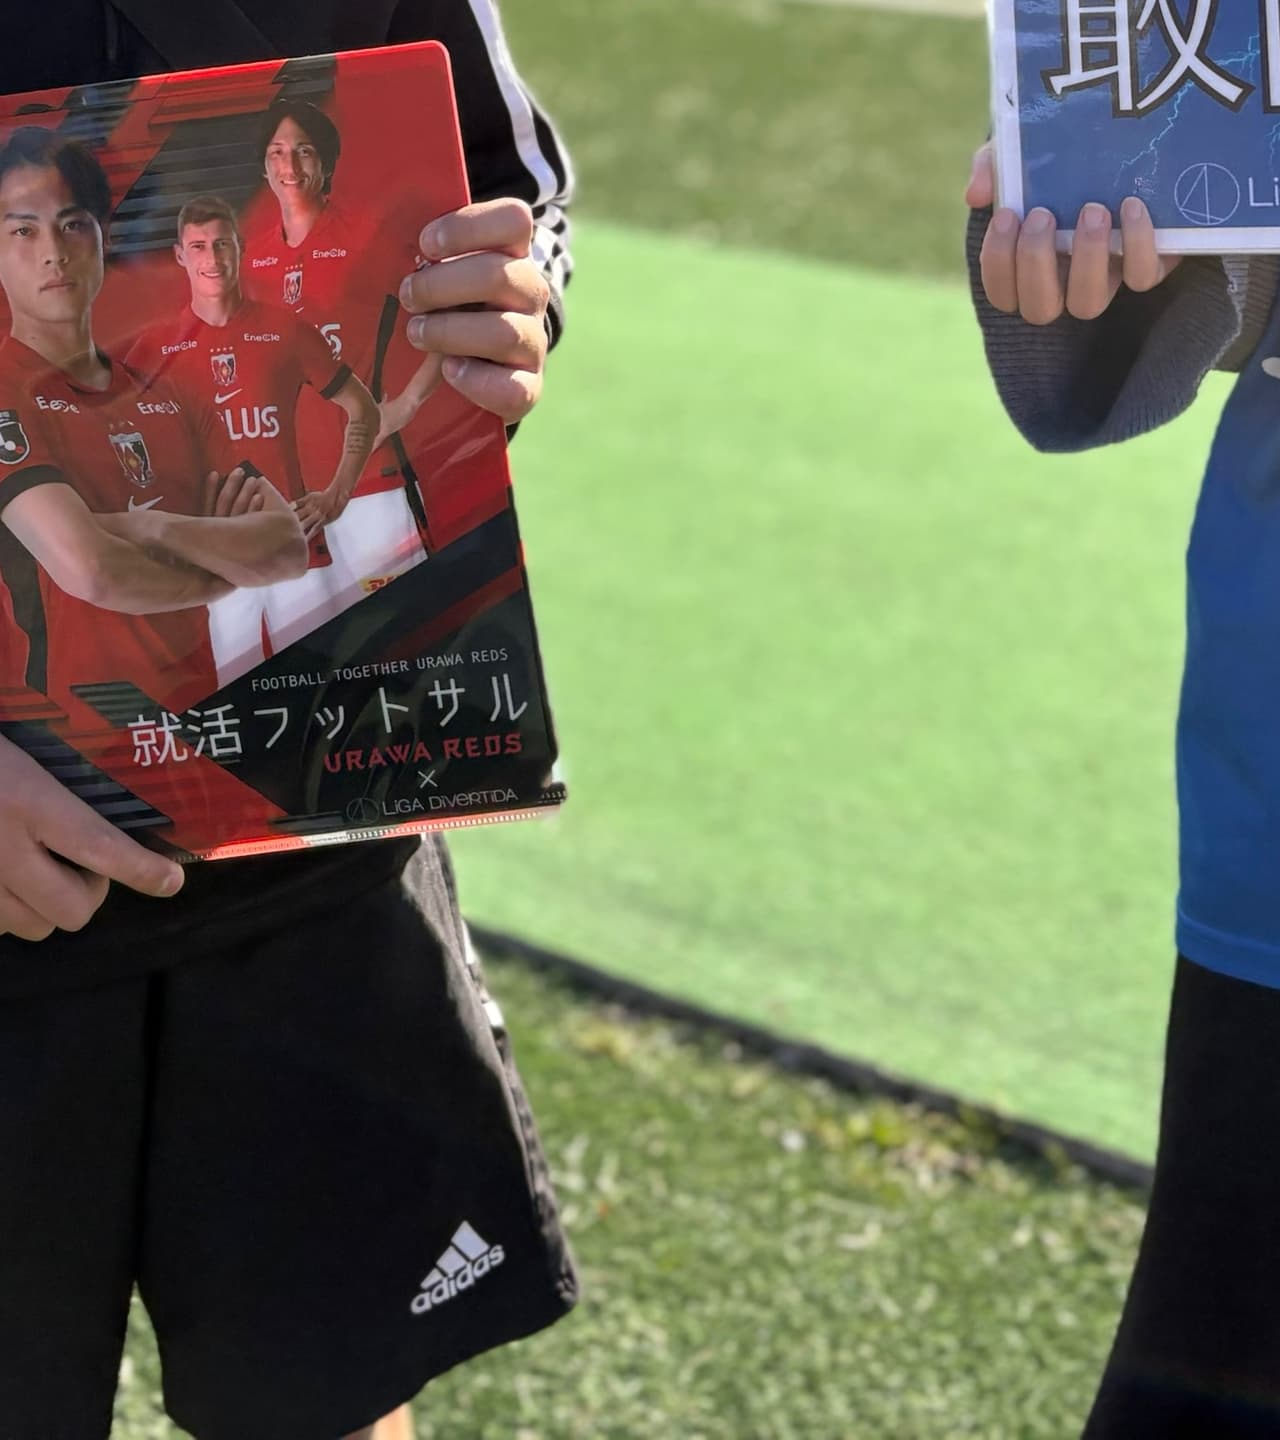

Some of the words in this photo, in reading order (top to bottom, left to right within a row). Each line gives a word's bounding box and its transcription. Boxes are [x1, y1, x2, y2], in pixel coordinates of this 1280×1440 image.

[216, 405, 280, 441] LUS
[251, 671, 326, 692] FOOTBALL
[334, 659, 410, 681] TOGETHER
[416, 652, 465, 671] URAWA
[471, 647, 509, 665] REDS
[127, 672, 528, 767] 就活フットサル
[323, 740, 433, 774] URAWA
[443, 732, 523, 761] REDS
[410, 1244, 506, 1315] adidas
